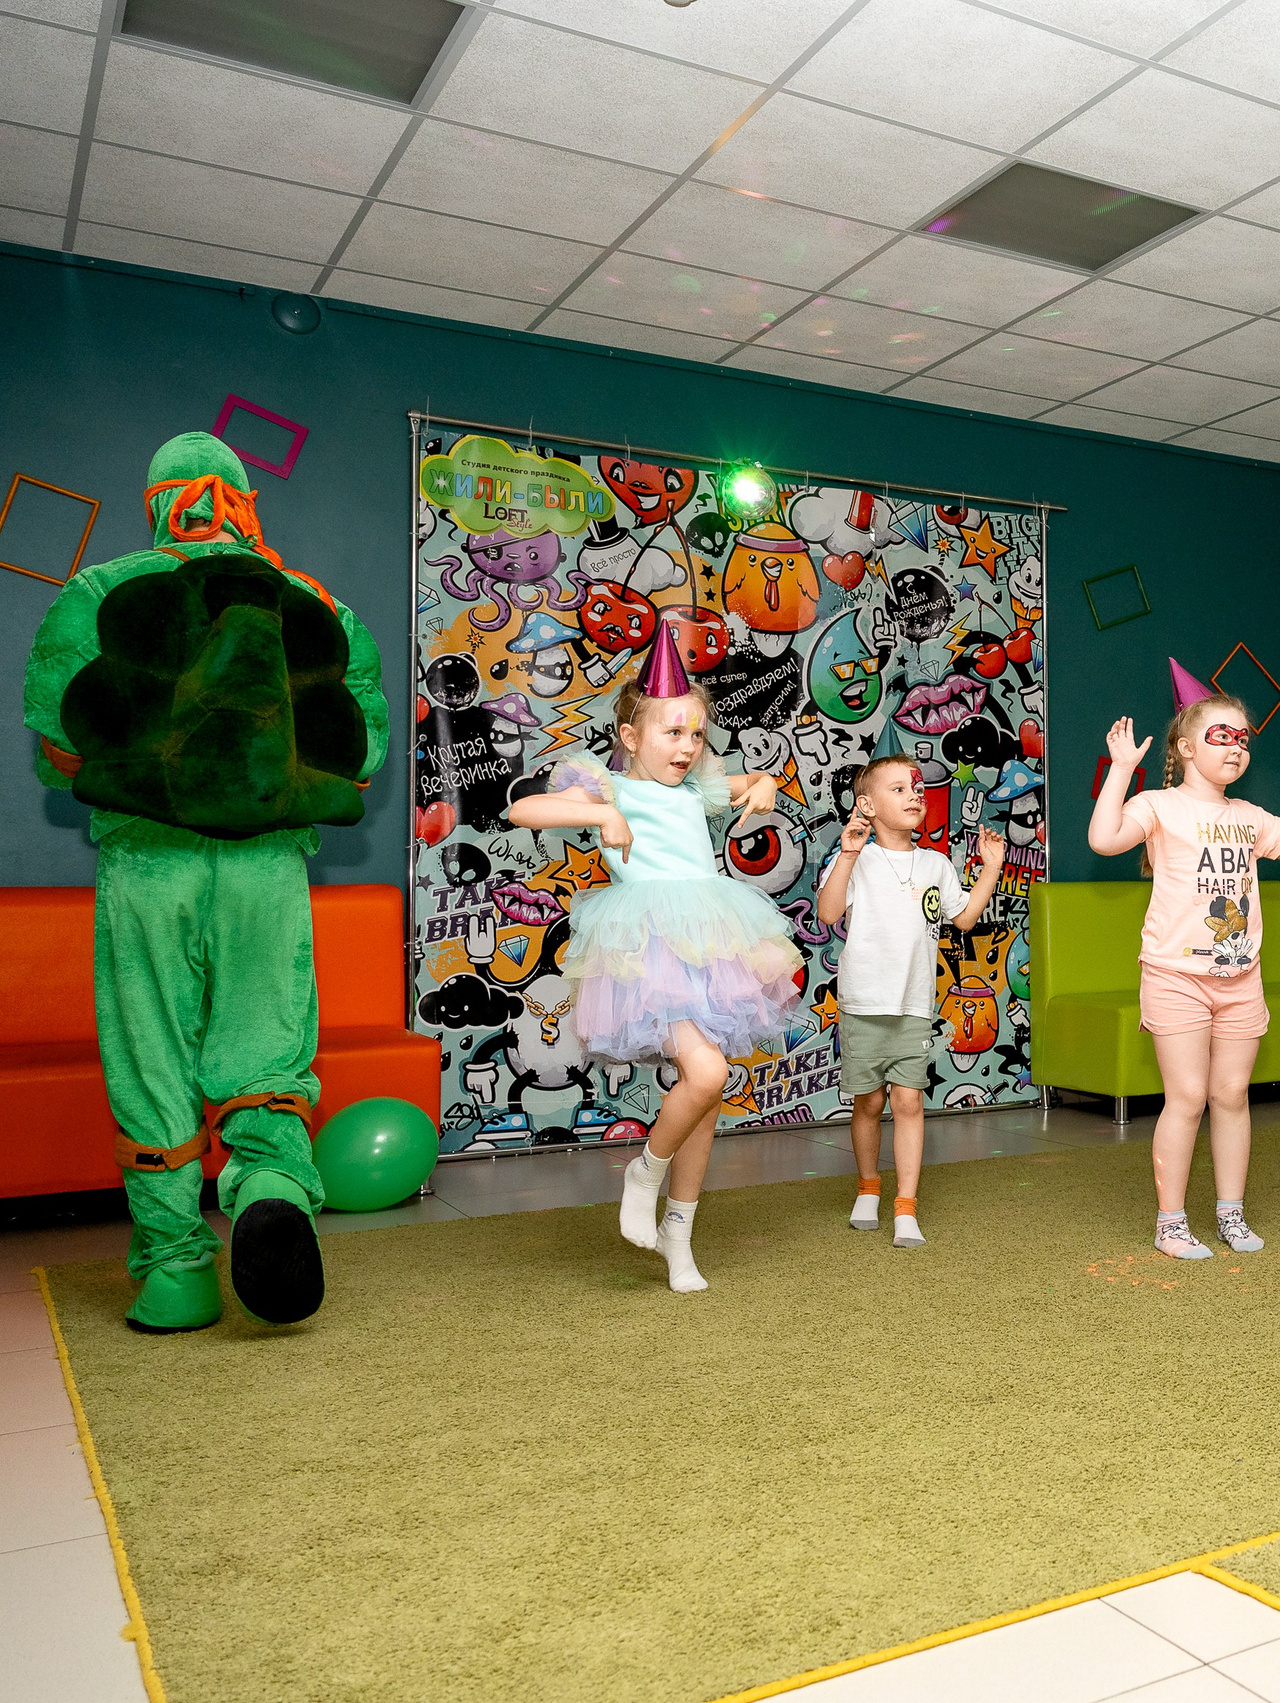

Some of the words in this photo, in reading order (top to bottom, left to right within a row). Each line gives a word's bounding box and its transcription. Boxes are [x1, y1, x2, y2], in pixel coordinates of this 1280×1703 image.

[461, 459, 491, 469] Студия
[492, 465, 528, 475] детского
[530, 470, 571, 483] праздника
[429, 468, 604, 514] ЖИЛИ-БЫЛИ
[483, 502, 528, 523] LOFT
[990, 514, 1041, 540] BIG
[608, 548, 636, 564] просто
[720, 672, 748, 684] супер
[427, 737, 488, 771] Крутая
[1196, 822, 1257, 845] HAVING
[1197, 847, 1216, 873] A
[433, 872, 525, 913] TAK
[999, 862, 1044, 897] REE
[1198, 876, 1236, 895] HAIR
[753, 1044, 831, 1088] TAKE
